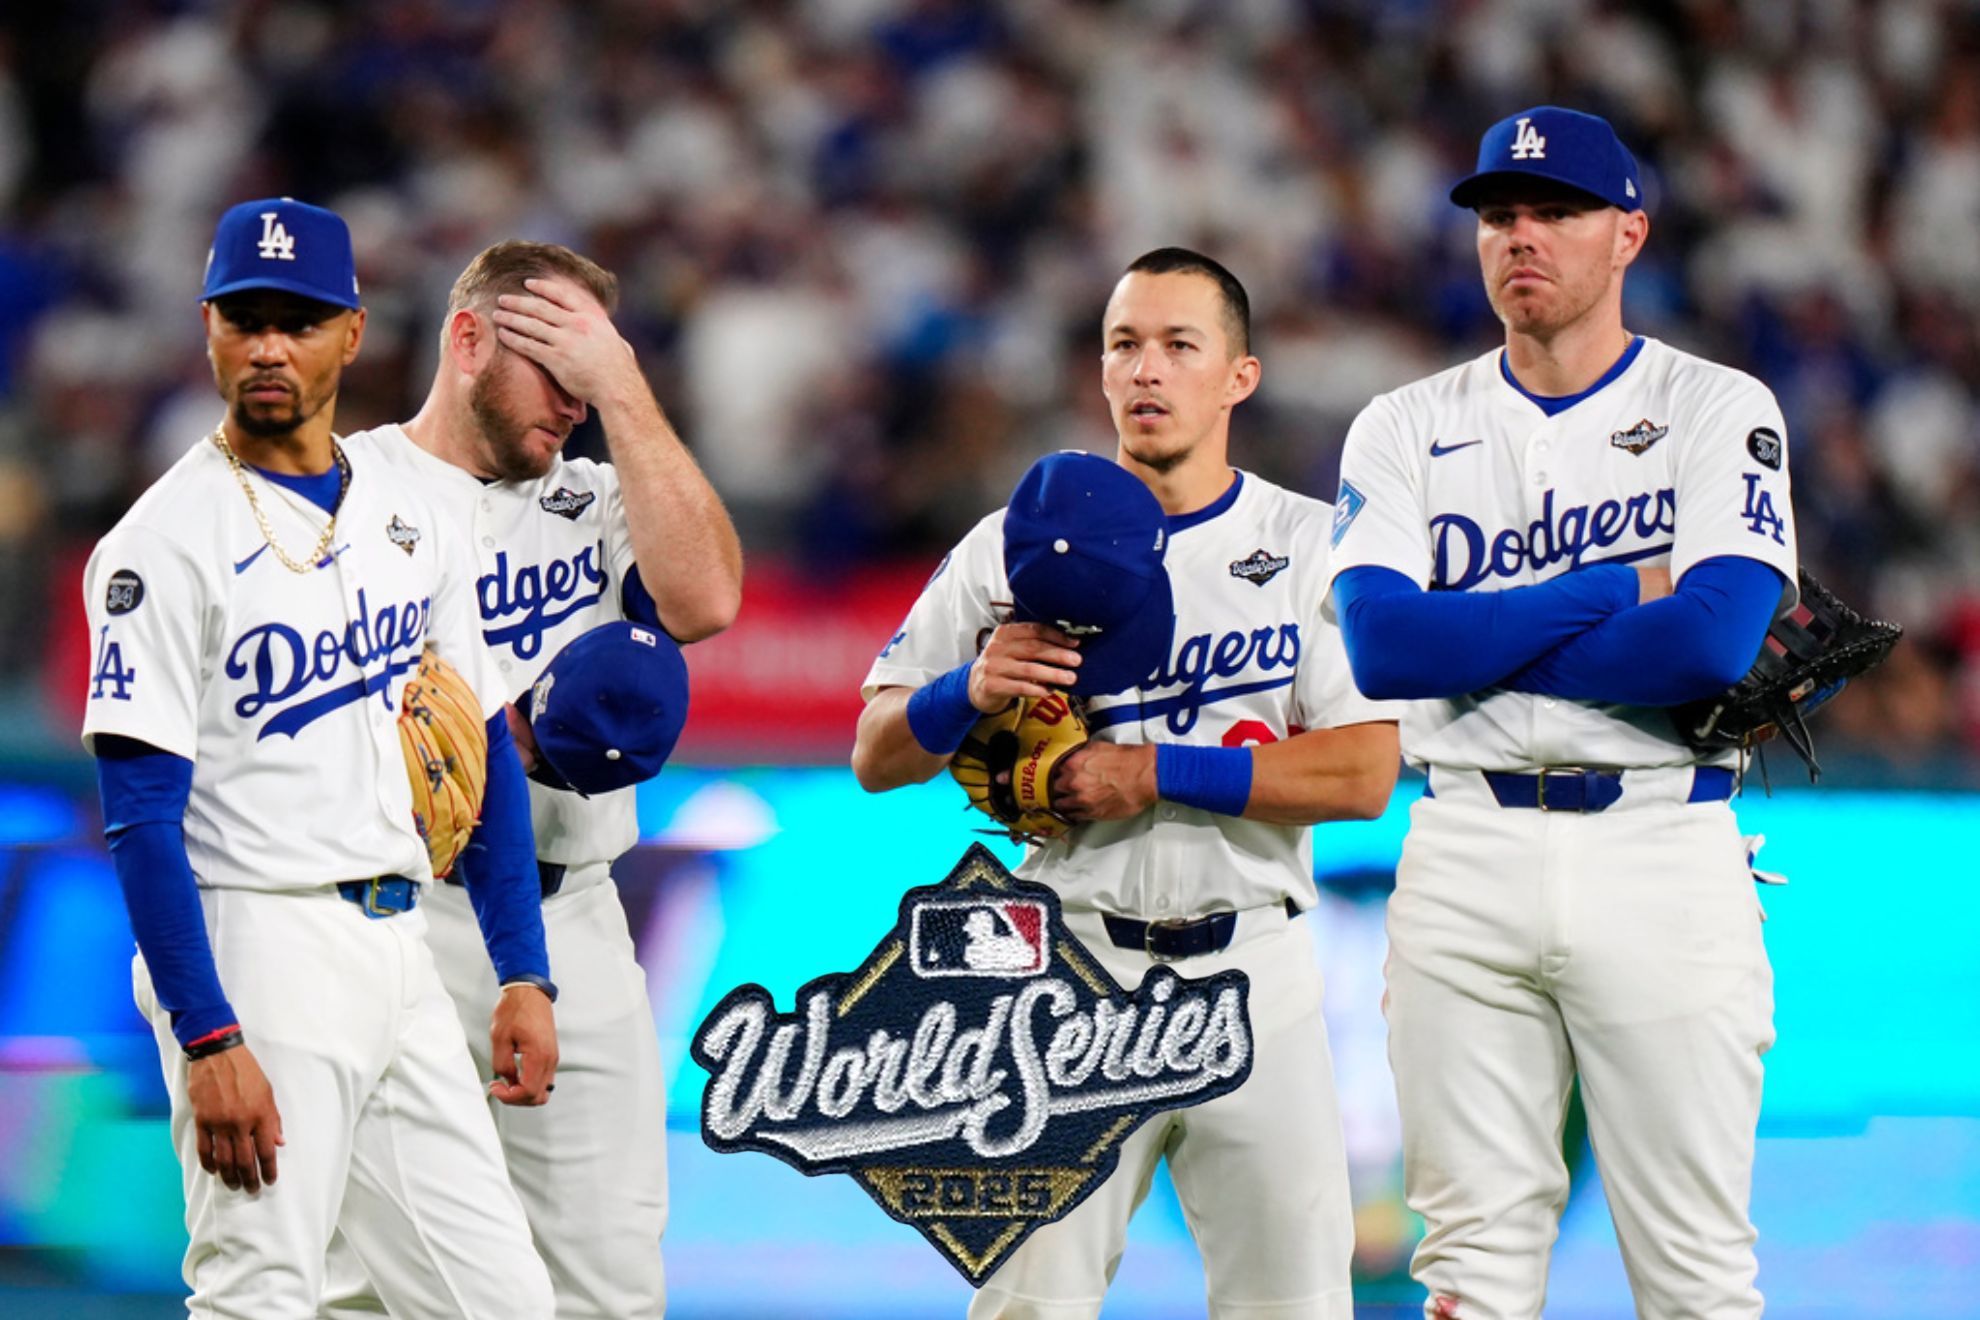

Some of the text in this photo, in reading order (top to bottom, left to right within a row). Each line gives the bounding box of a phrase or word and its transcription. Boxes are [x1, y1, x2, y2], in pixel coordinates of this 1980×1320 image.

[1510, 117, 1546, 160] LA
[257, 212, 296, 260] LA
[1429, 488, 1675, 592] Dodgers
[1740, 472, 1786, 547] LA
[476, 538, 609, 661] dger
[225, 587, 431, 719] Dodger
[1021, 738, 1051, 801] Wilson
